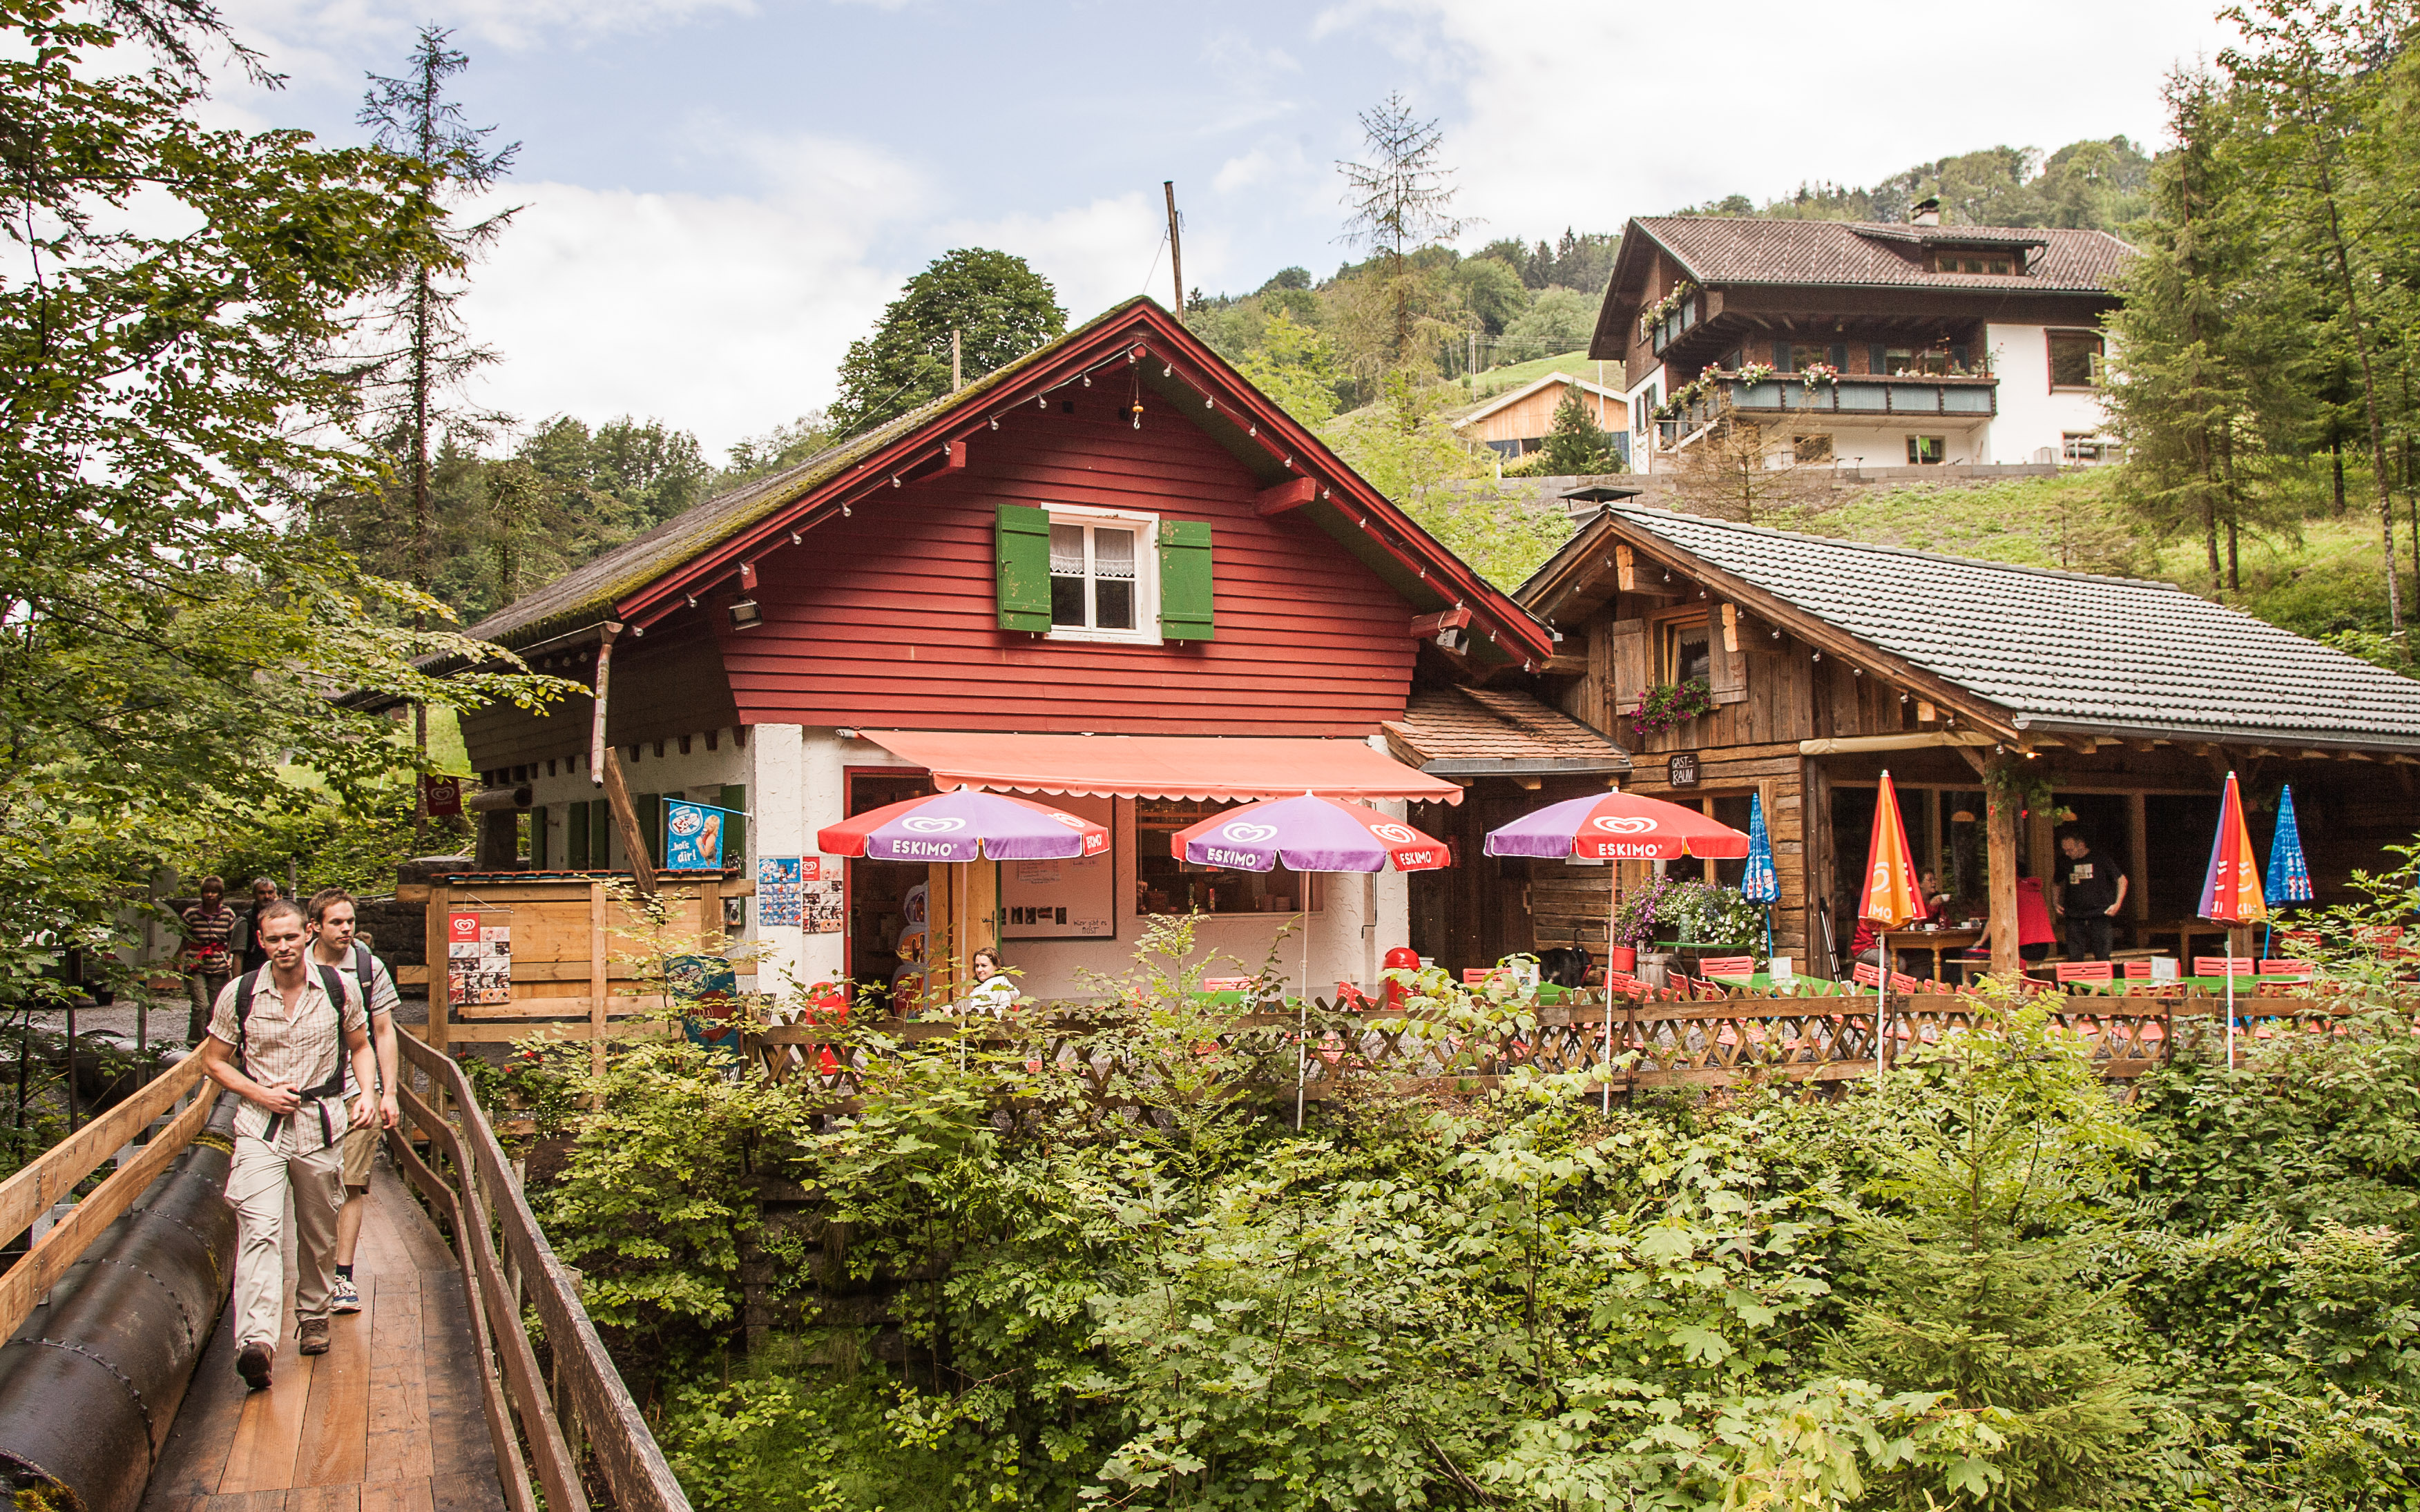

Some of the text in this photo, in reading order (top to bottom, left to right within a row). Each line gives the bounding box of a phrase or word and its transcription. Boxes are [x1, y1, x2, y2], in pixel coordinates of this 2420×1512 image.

[1673, 768, 1693, 782] RAUM
[677, 849, 697, 863] dir!
[892, 840, 952, 857] ESKIMO
[1597, 843, 1658, 857] ESKIMO
[1207, 847, 1256, 866] ESKIMO
[1399, 851, 1432, 866] ESKIMO
[1867, 903, 1892, 920] IMO
